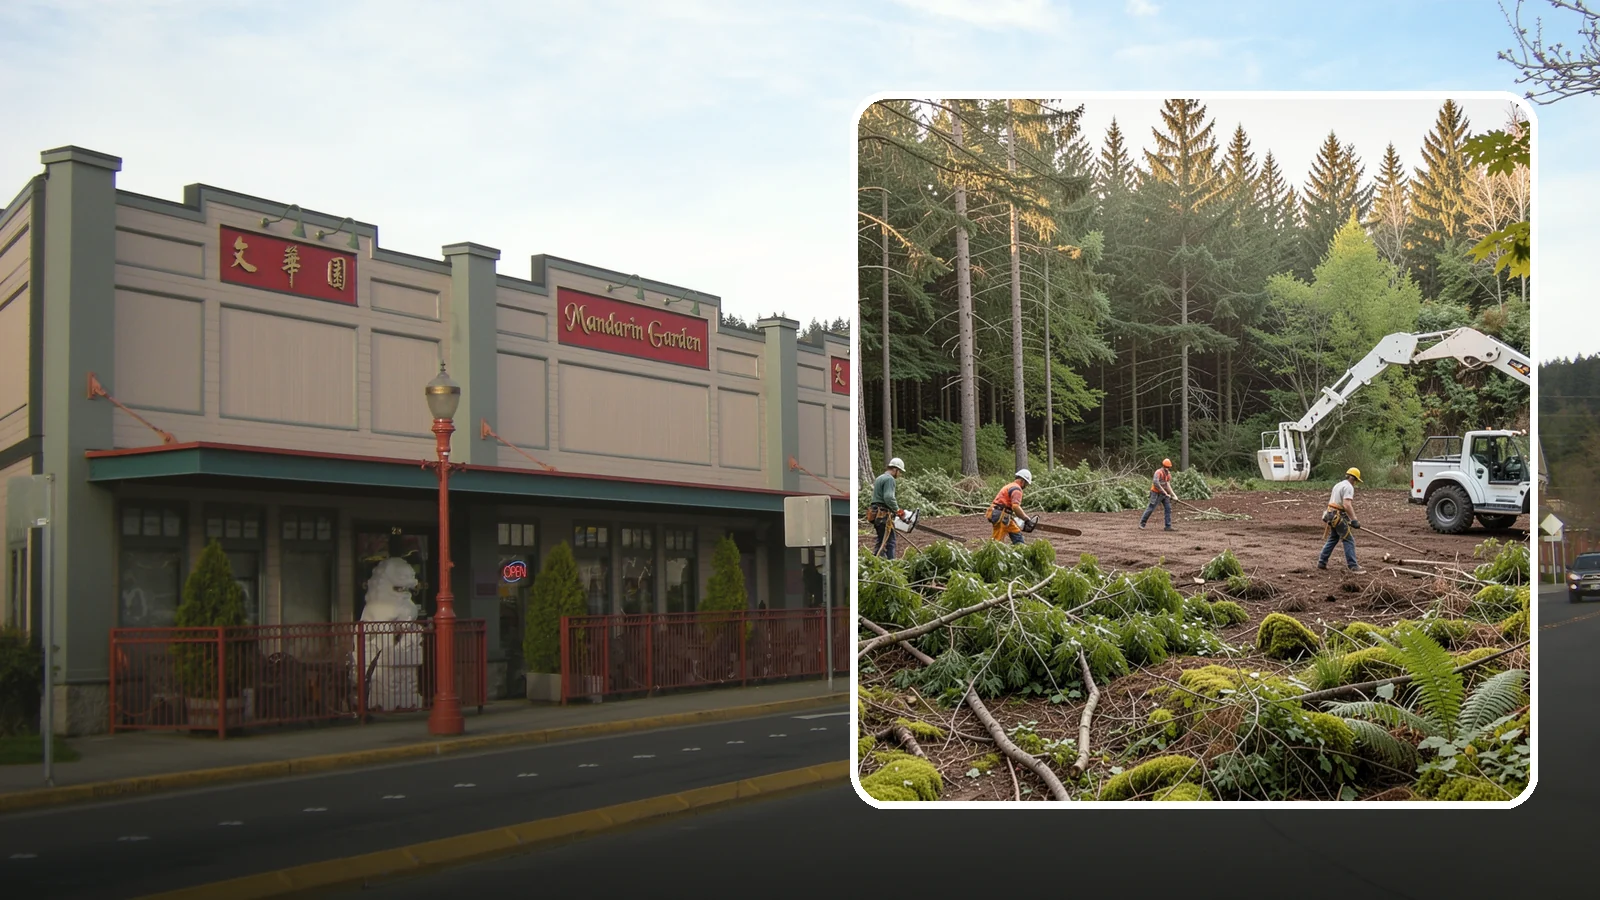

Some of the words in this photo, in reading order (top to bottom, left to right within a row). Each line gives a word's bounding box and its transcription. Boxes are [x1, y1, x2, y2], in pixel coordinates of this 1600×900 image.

[231, 236, 346, 290] 文華園
[565, 303, 644, 341] Mandarin
[648, 320, 701, 351] Garden
[503, 565, 527, 578] OPEN
